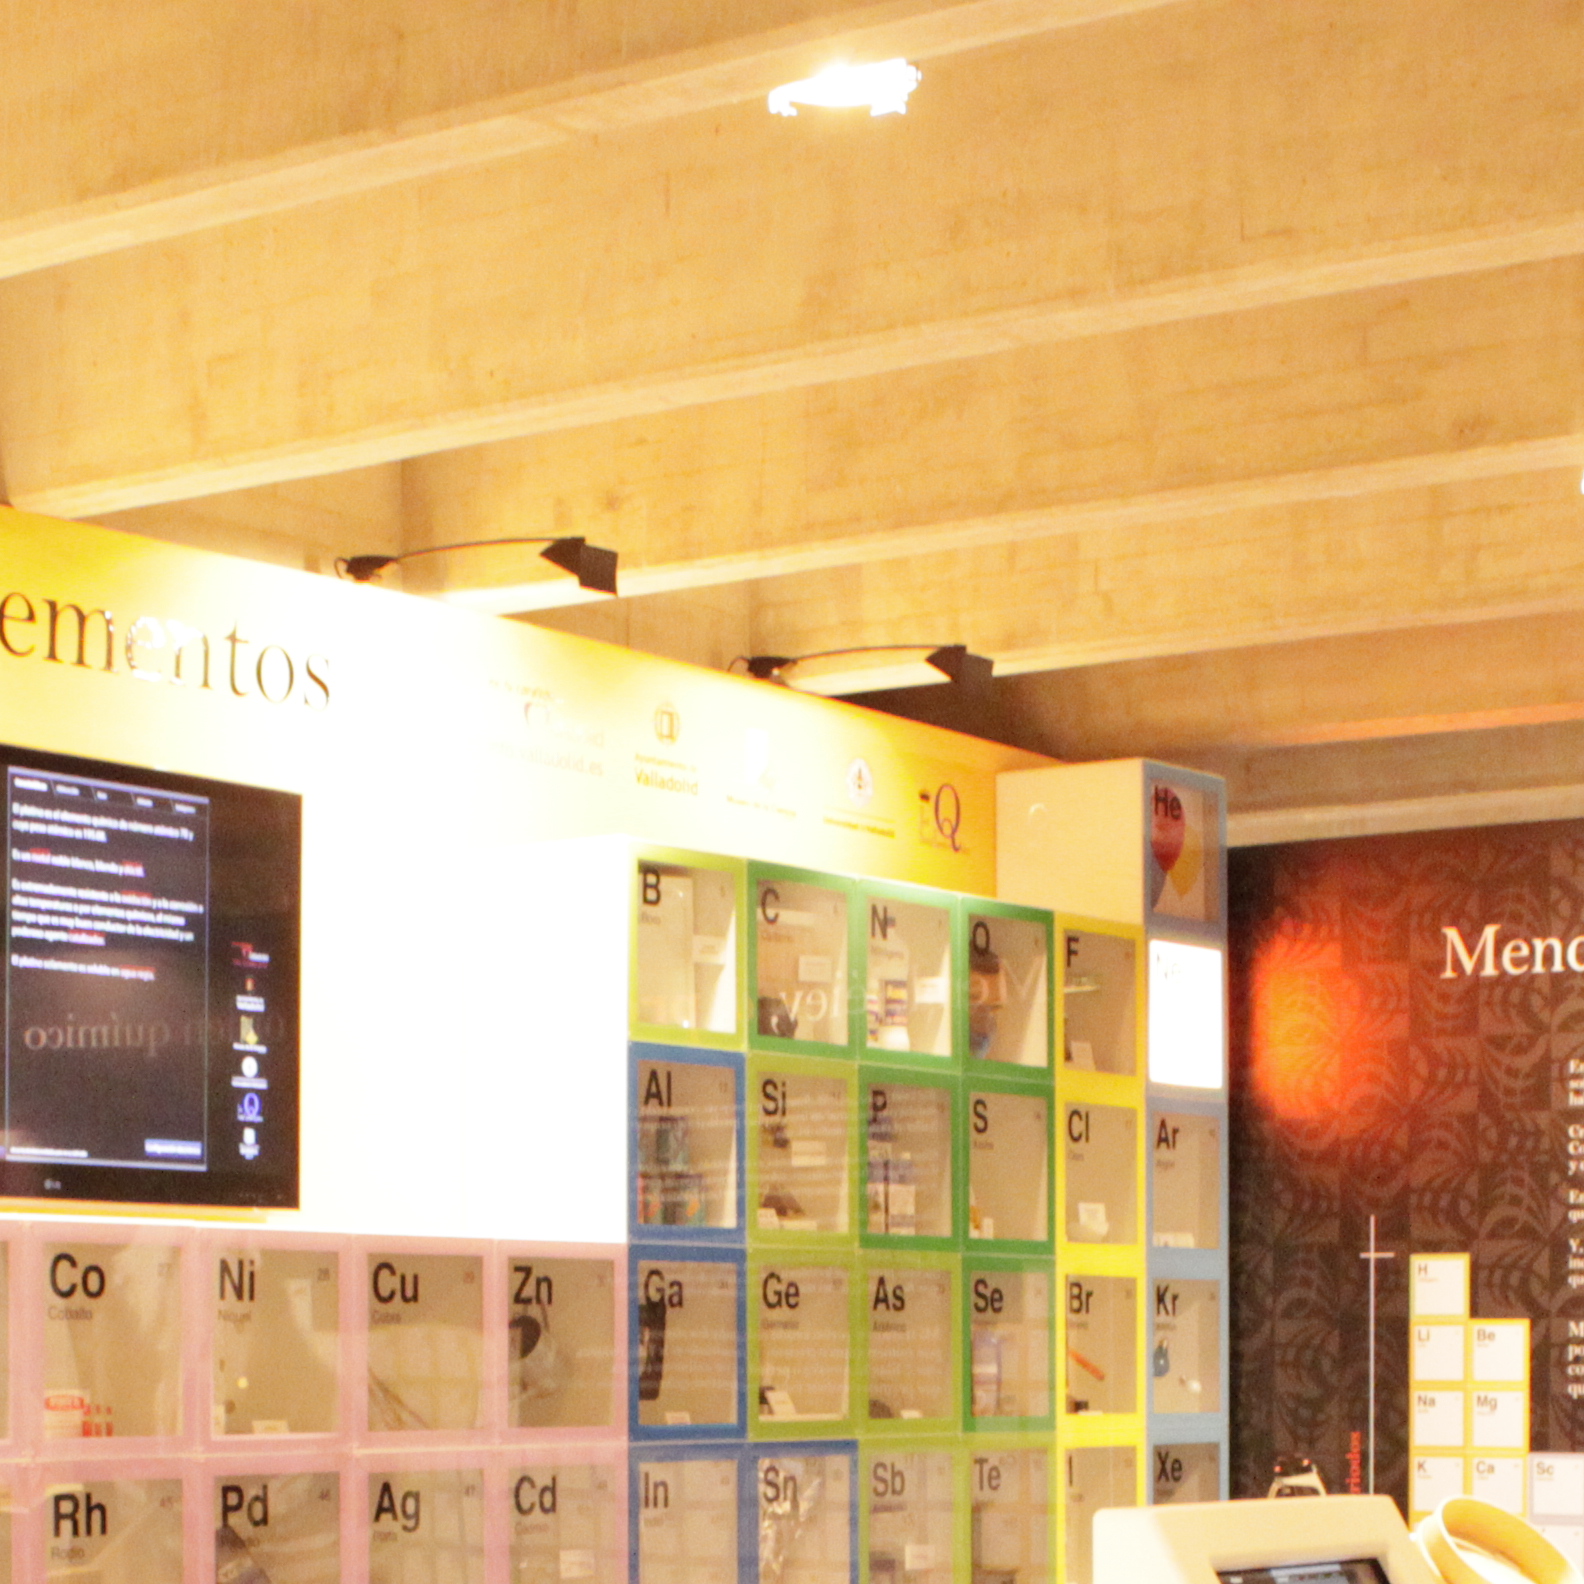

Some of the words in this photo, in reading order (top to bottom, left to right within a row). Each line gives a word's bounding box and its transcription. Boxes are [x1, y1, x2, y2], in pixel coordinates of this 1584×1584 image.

[1153, 784, 1182, 821] He
[642, 870, 662, 906] B
[760, 886, 779, 924] C
[1066, 936, 1080, 969] F
[644, 1070, 673, 1109] Al
[762, 1080, 787, 1117] Si
[972, 1100, 989, 1135] S
[1068, 1109, 1090, 1144] Cl
[1155, 1118, 1180, 1152] Ar
[49, 1252, 106, 1299] Co
[218, 1258, 256, 1303] Ni
[372, 1262, 419, 1305] Cu
[513, 1266, 553, 1305] Zn
[644, 1269, 684, 1310] Ga
[761, 1272, 800, 1310] Ge
[872, 1276, 906, 1313] As
[973, 1279, 1004, 1315] Se
[1068, 1283, 1093, 1316] Br
[1155, 1285, 1179, 1317] Kr
[872, 1462, 906, 1499] Sb
[973, 1456, 1002, 1492] Te
[1156, 1451, 1183, 1484] Xe
[514, 1476, 557, 1516] Cd
[643, 1472, 670, 1509] In
[762, 1469, 799, 1506] Sn
[52, 1493, 107, 1538] Rh
[221, 1485, 269, 1528] Pd
[373, 1482, 421, 1531] Ag
